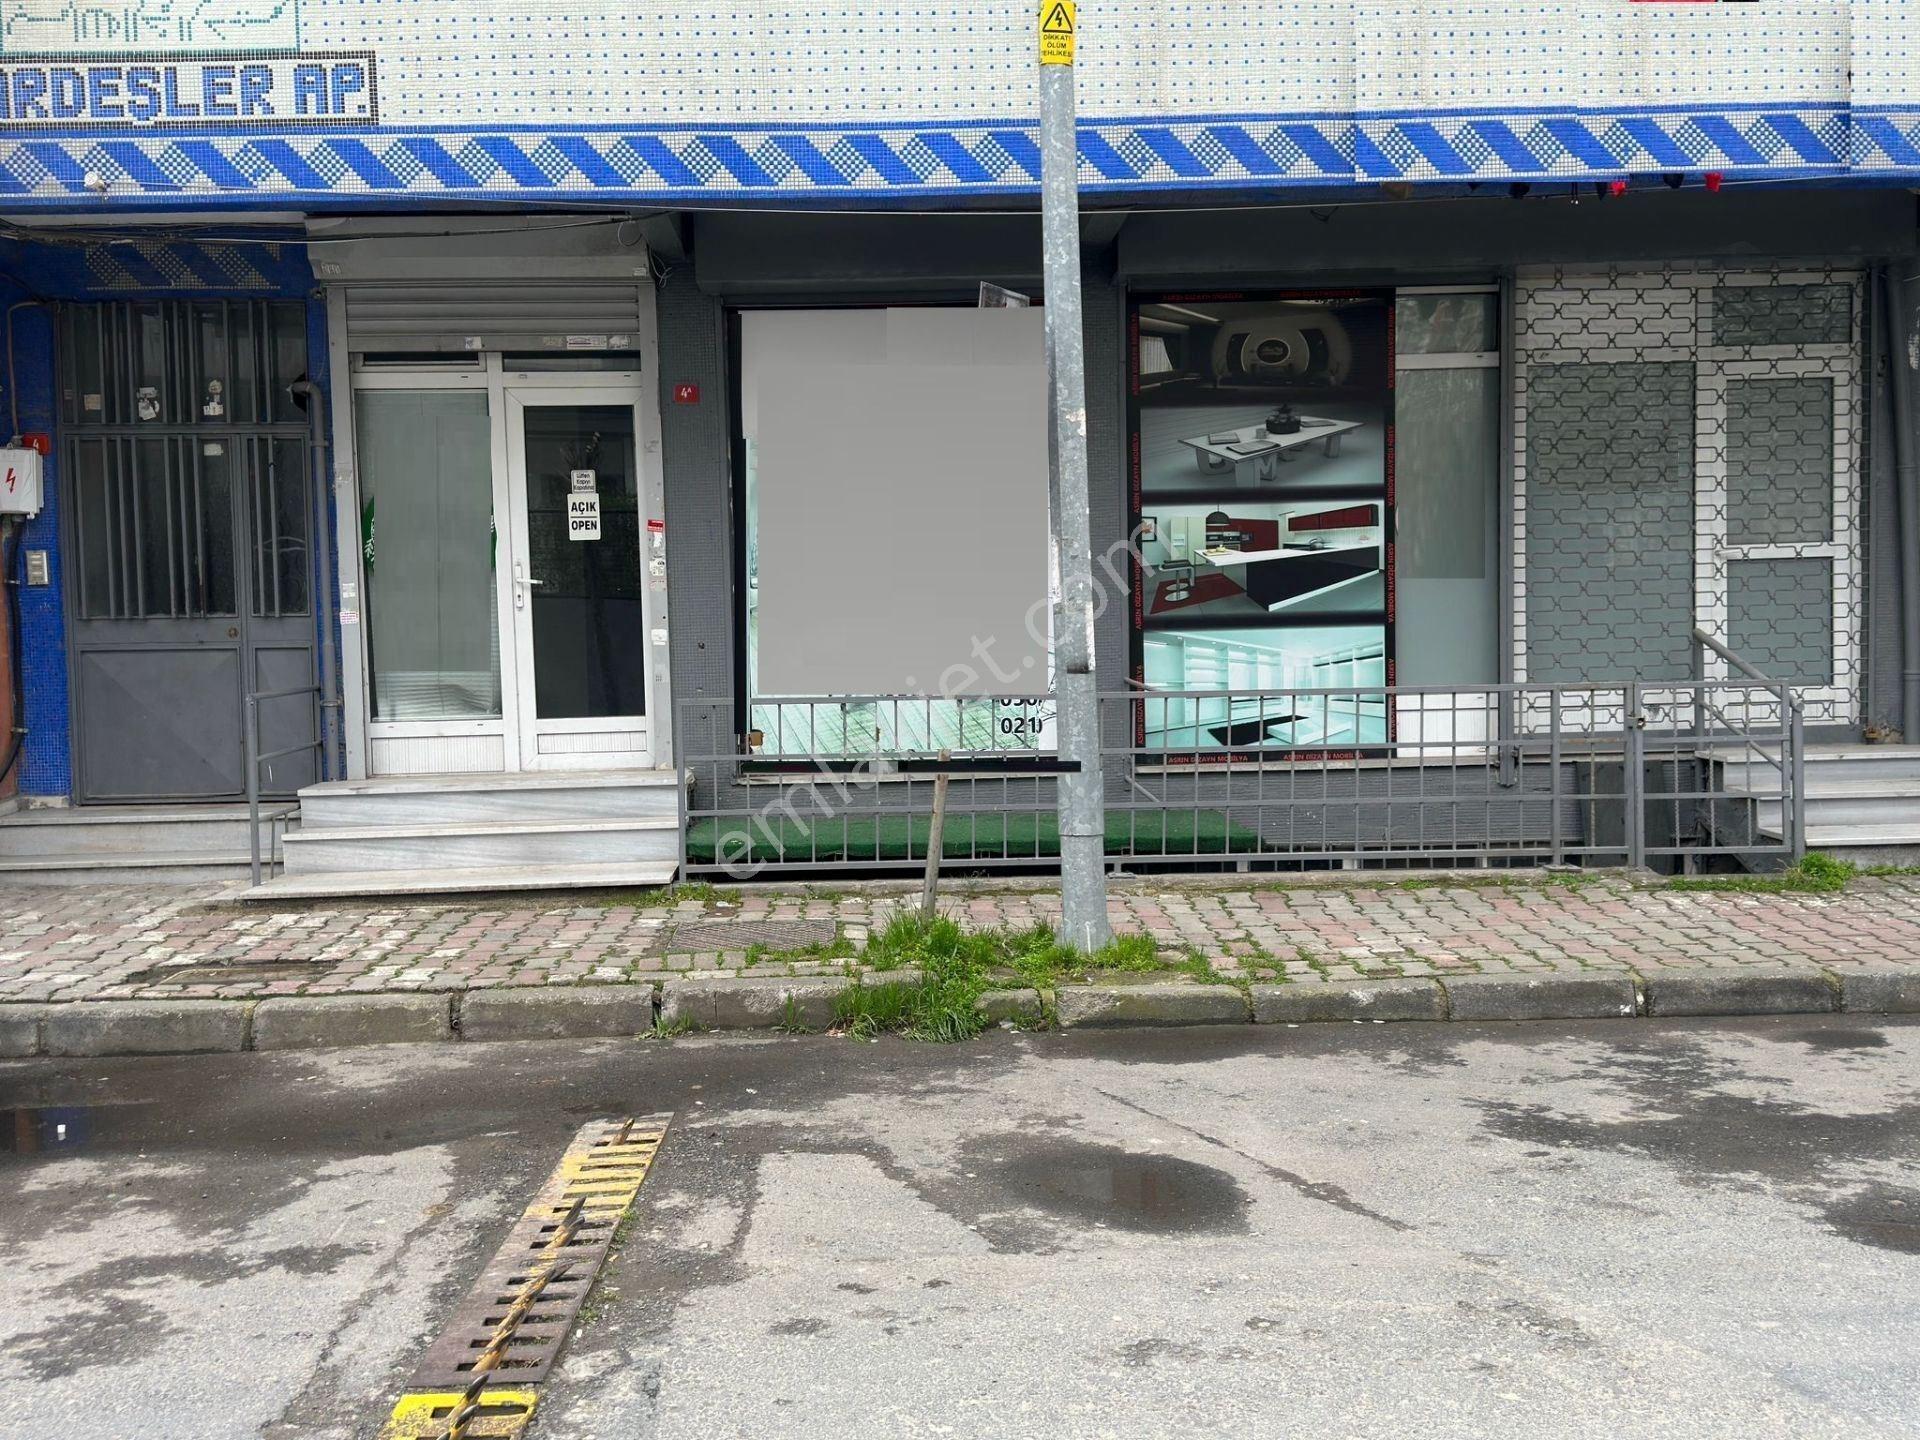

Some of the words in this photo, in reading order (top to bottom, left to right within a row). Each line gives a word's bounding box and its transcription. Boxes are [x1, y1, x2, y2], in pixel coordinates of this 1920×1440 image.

[0, 64, 275, 121] RDEŞLER
[294, 63, 368, 114] AP.
[571, 501, 597, 514] AÇIK
[571, 520, 597, 531] OPEN
